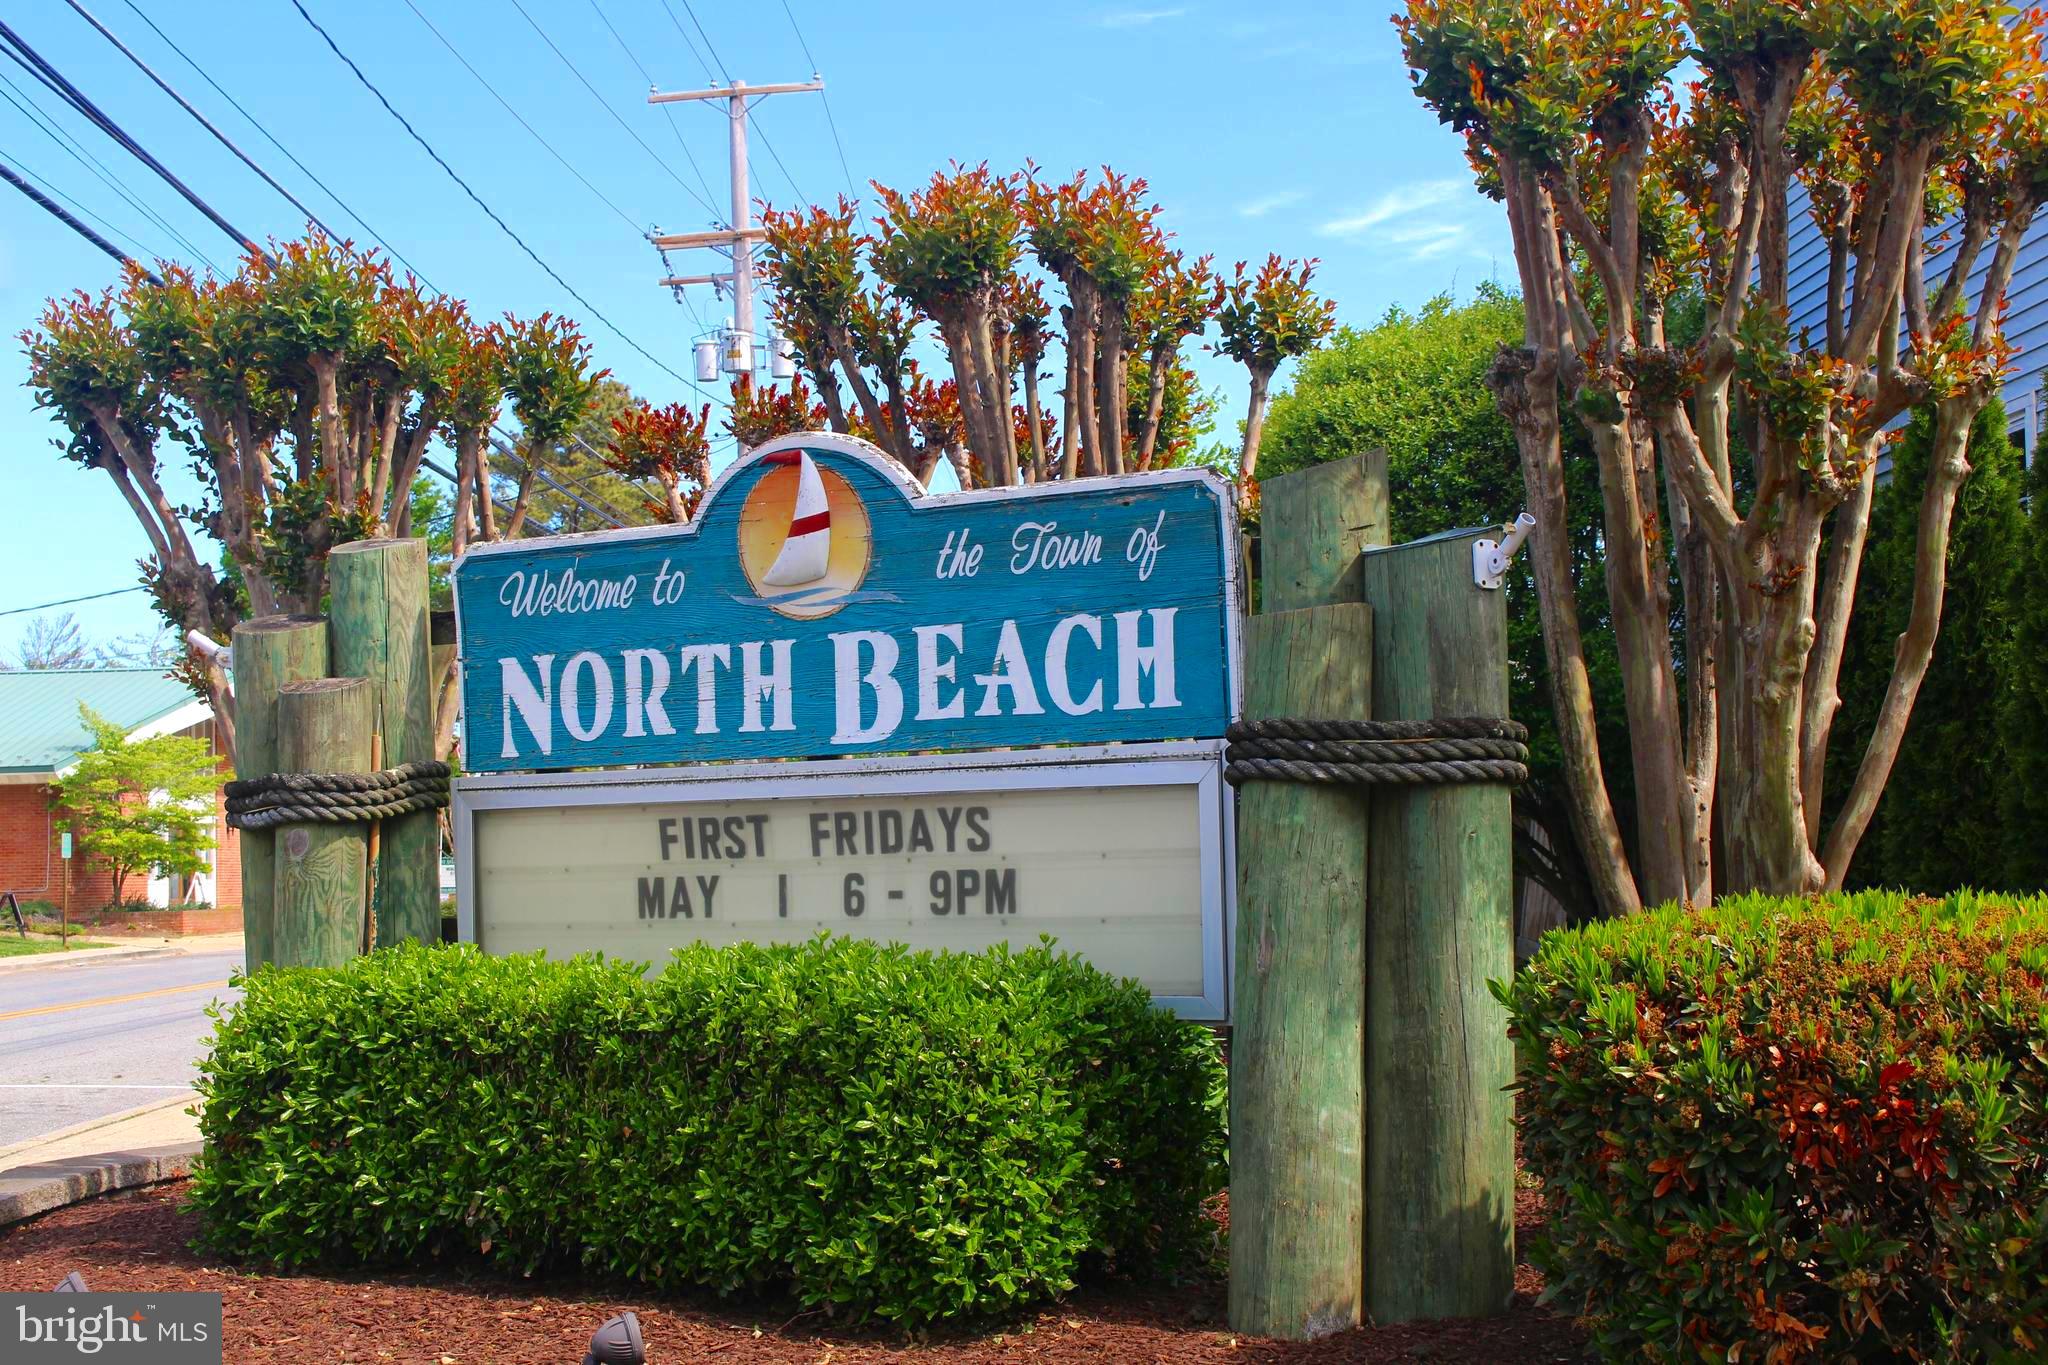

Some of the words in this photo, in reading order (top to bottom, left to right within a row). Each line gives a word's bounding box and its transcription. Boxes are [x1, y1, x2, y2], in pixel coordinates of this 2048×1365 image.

[936, 528, 984, 579] the
[1010, 521, 1102, 575] Town
[1126, 509, 1166, 582] of
[500, 567, 638, 618] Welcome
[652, 558, 686, 606] to
[498, 639, 797, 758] NORTH
[827, 607, 1182, 745] BEACH
[658, 814, 769, 861] FIRST
[809, 806, 991, 857] FRIDAYS
[637, 875, 720, 920] MAY
[843, 872, 865, 918] 6
[929, 868, 1017, 916] 9PM
